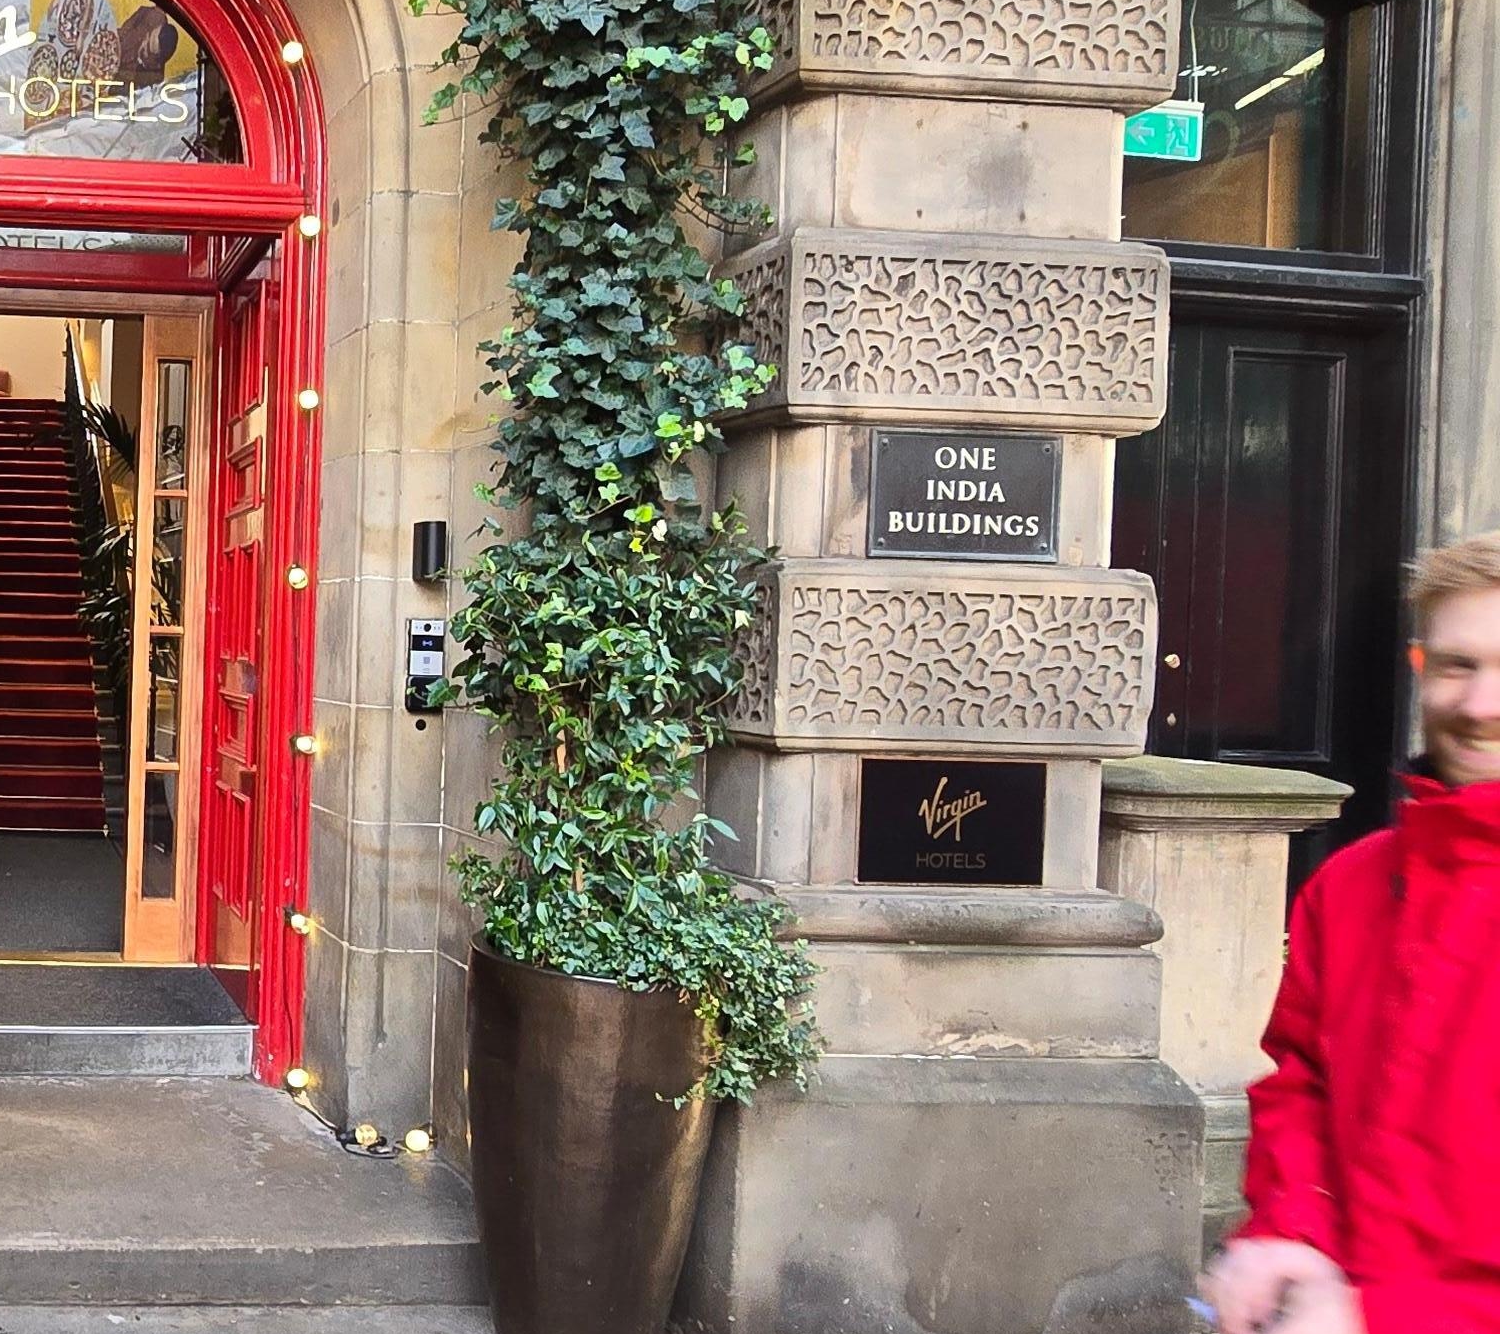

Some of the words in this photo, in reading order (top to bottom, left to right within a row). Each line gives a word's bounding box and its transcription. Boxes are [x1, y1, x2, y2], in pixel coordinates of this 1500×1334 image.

[934, 446, 997, 471] ONE
[926, 479, 1006, 502] INDIA
[888, 511, 1039, 536] BUILDINGS
[918, 776, 987, 842] Virgin
[916, 852, 986, 869] HOTELS
